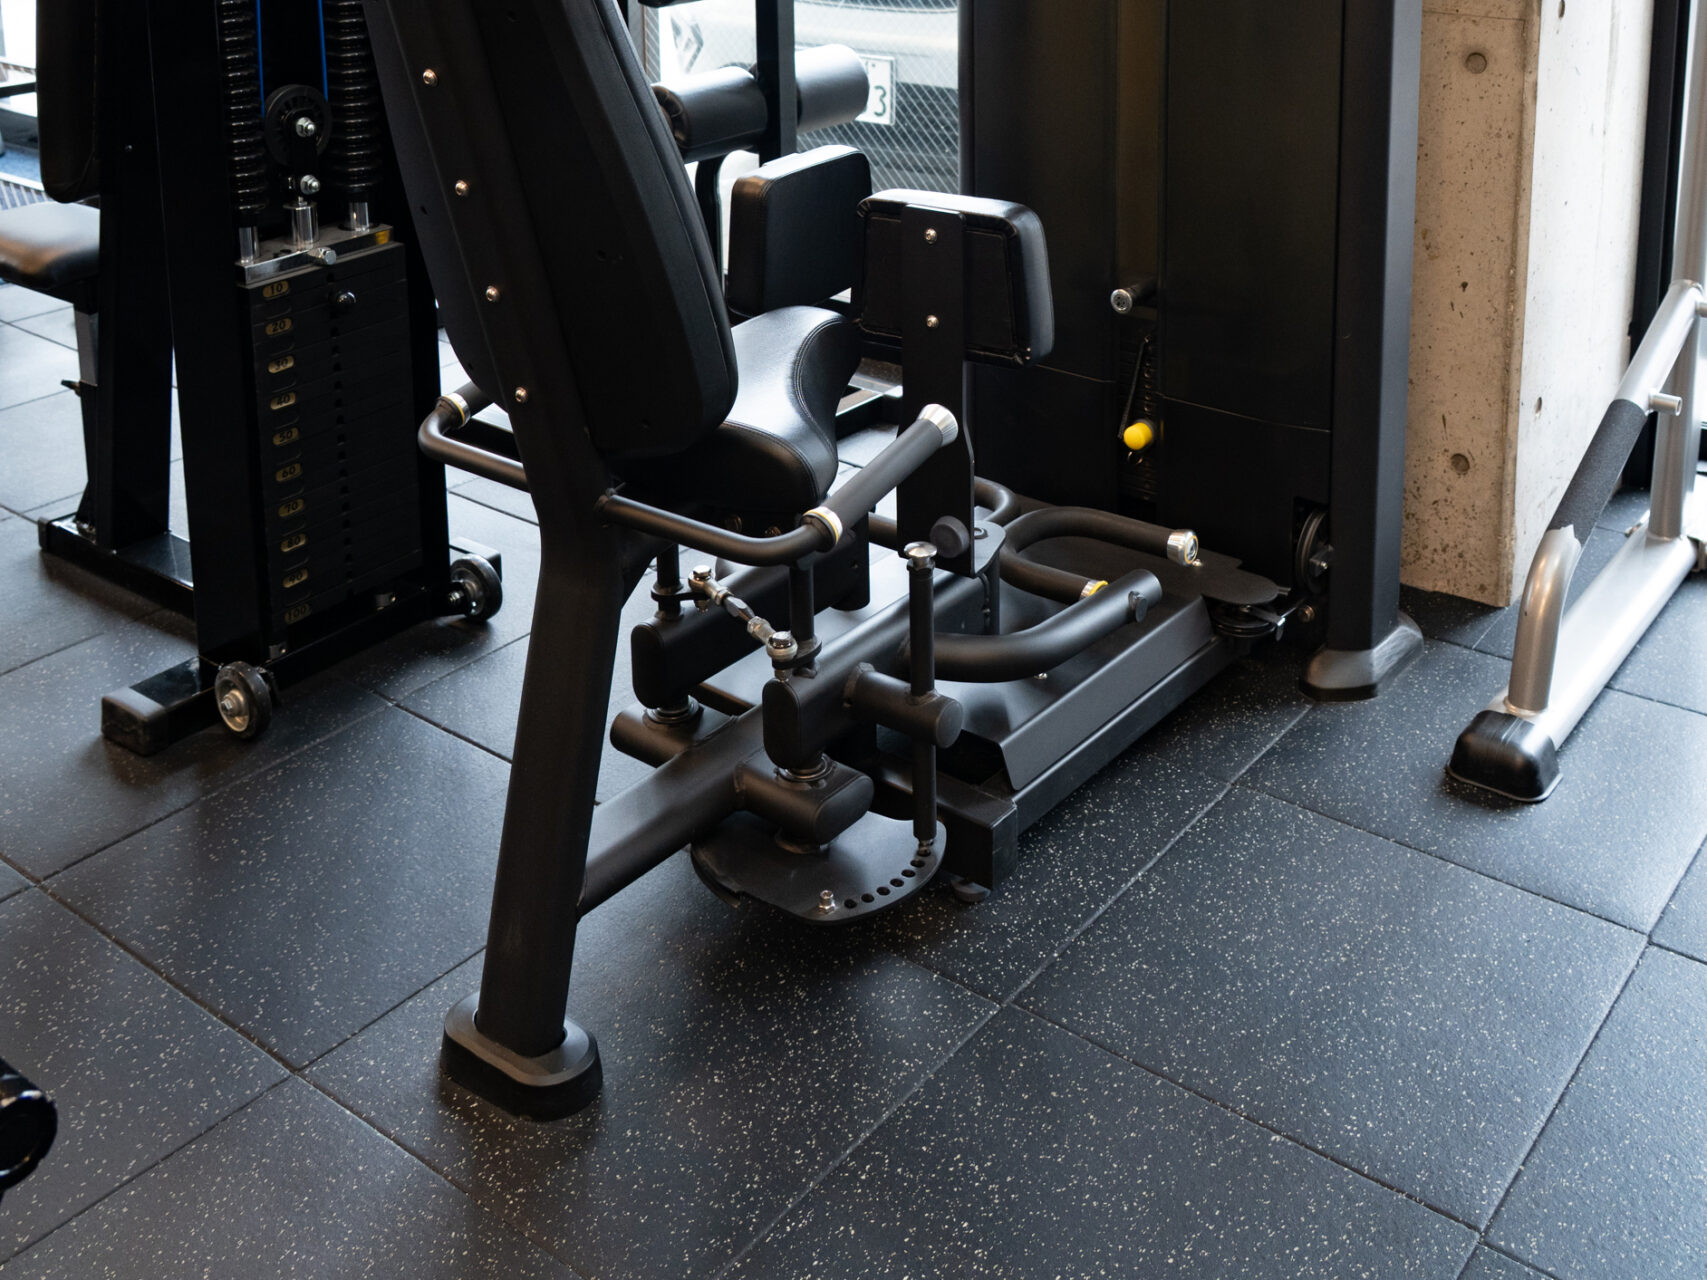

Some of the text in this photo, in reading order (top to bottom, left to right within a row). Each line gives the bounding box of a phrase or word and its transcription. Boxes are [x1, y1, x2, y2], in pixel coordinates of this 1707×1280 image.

[270, 283, 283, 295] 10
[272, 320, 286, 332] 20
[277, 394, 290, 406] 40
[279, 430, 293, 443] 50
[282, 466, 296, 478] 60
[286, 501, 298, 514] 70
[288, 605, 307, 621] 100
